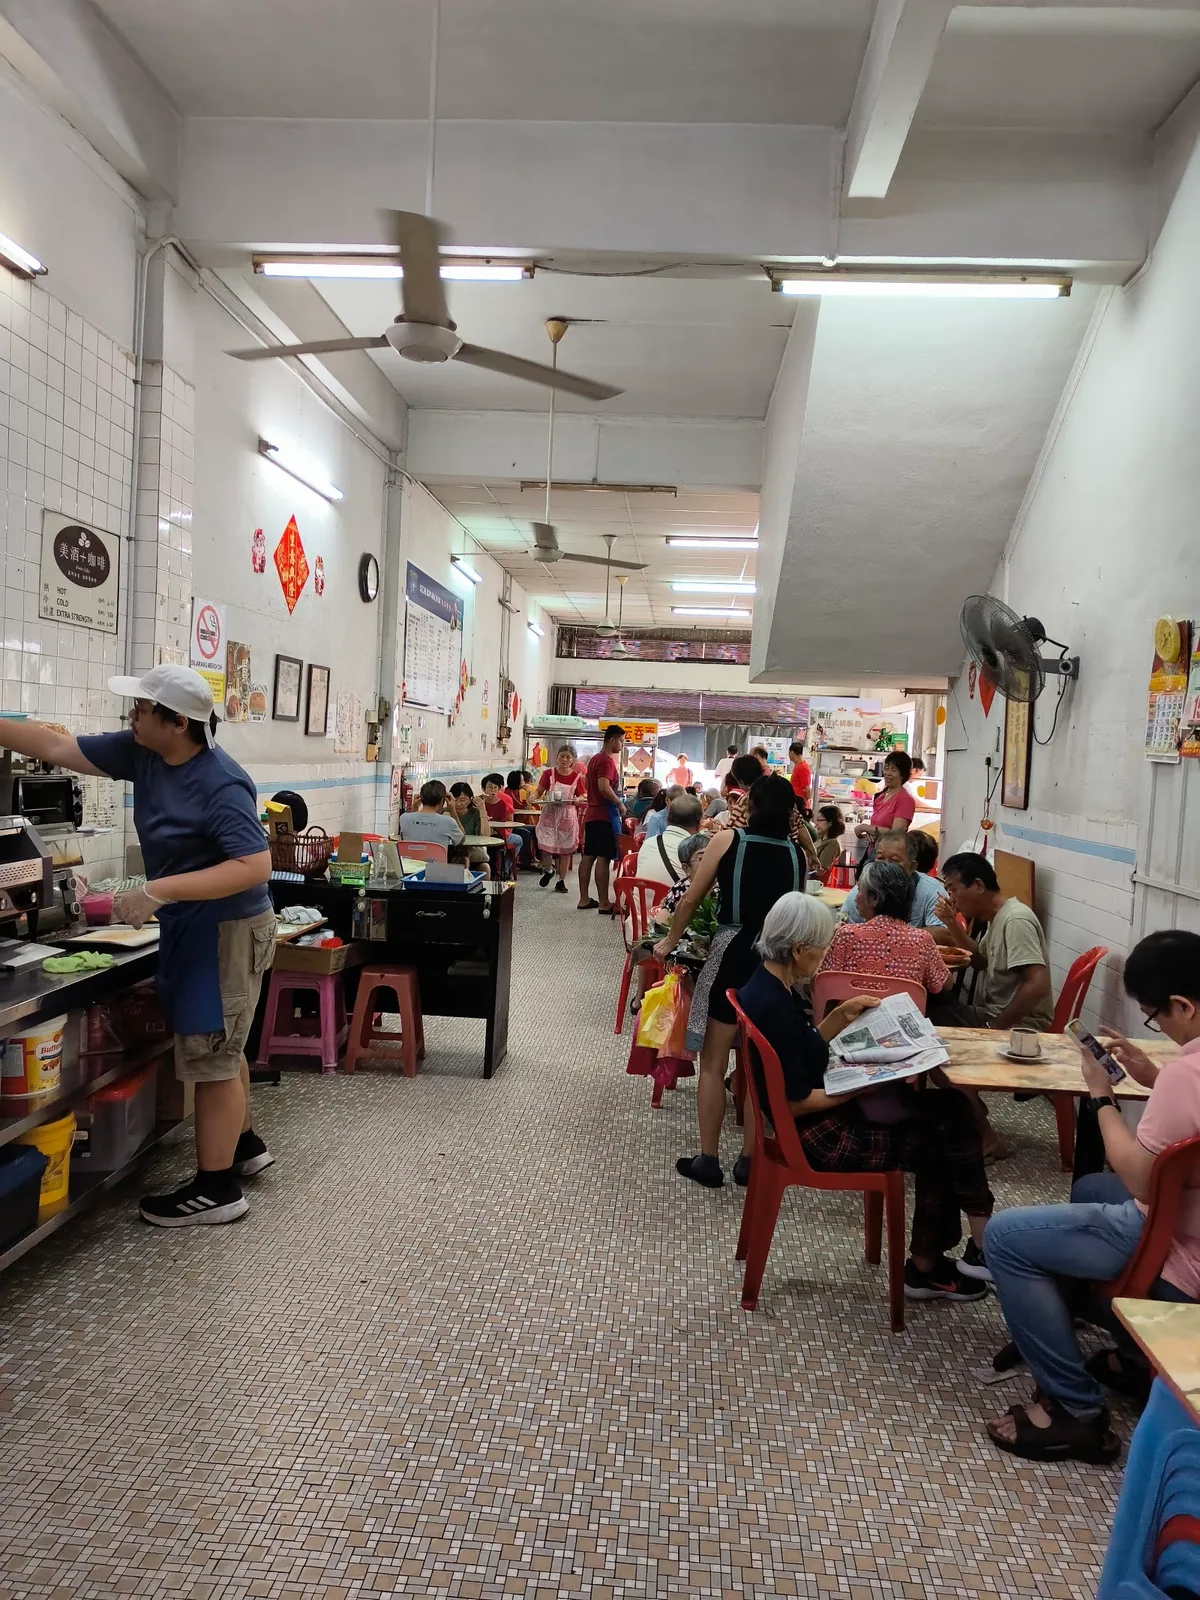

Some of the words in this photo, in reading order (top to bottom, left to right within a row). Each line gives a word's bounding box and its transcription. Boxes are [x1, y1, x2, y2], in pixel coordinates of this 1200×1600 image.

[57, 586, 67, 595] HOT
[57, 598, 69, 607] COLD
[57, 609, 70, 619] EXTRA
[71, 613, 93, 624] STRENGTH
